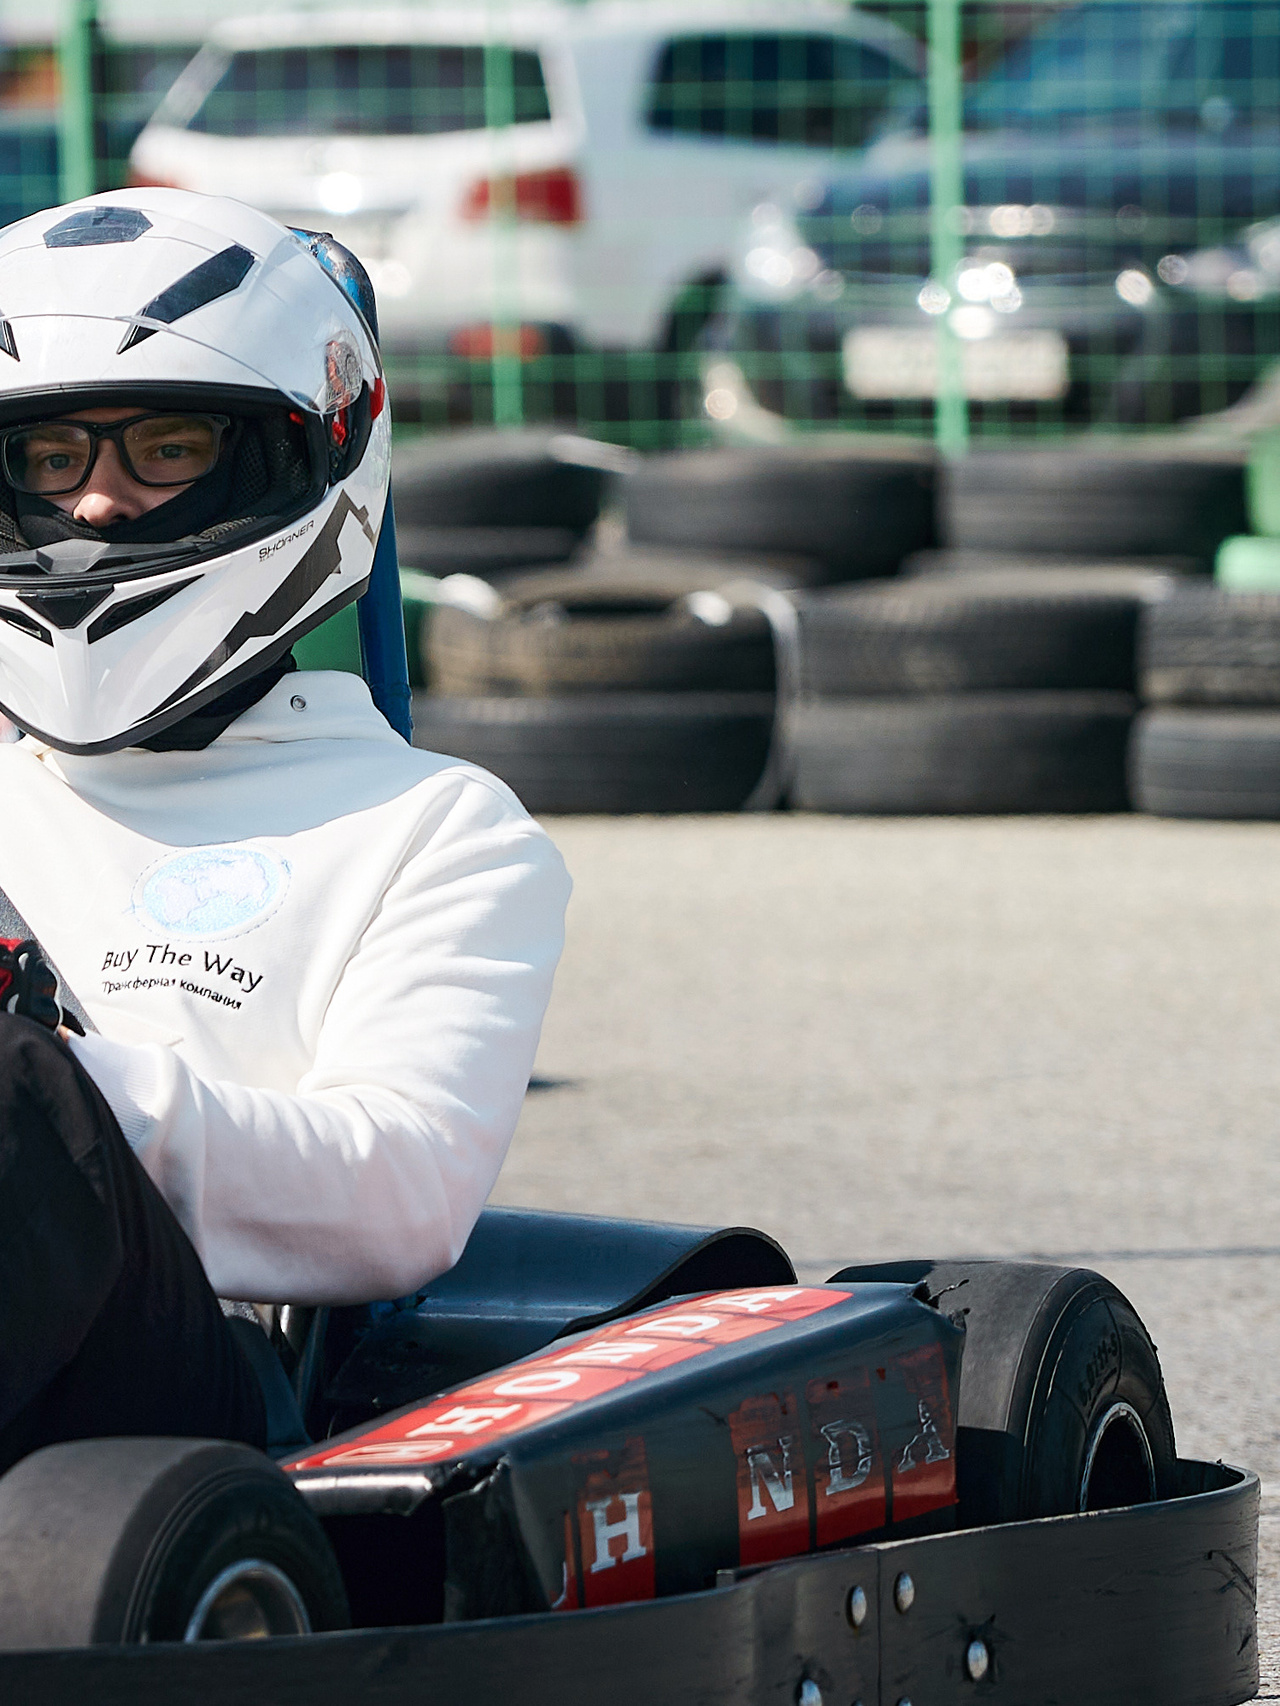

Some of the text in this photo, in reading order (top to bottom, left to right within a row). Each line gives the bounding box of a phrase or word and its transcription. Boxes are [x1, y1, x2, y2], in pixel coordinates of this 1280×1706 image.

[101, 943, 264, 993] Buy The Way
[102, 976, 243, 1010] Трансферная компания
